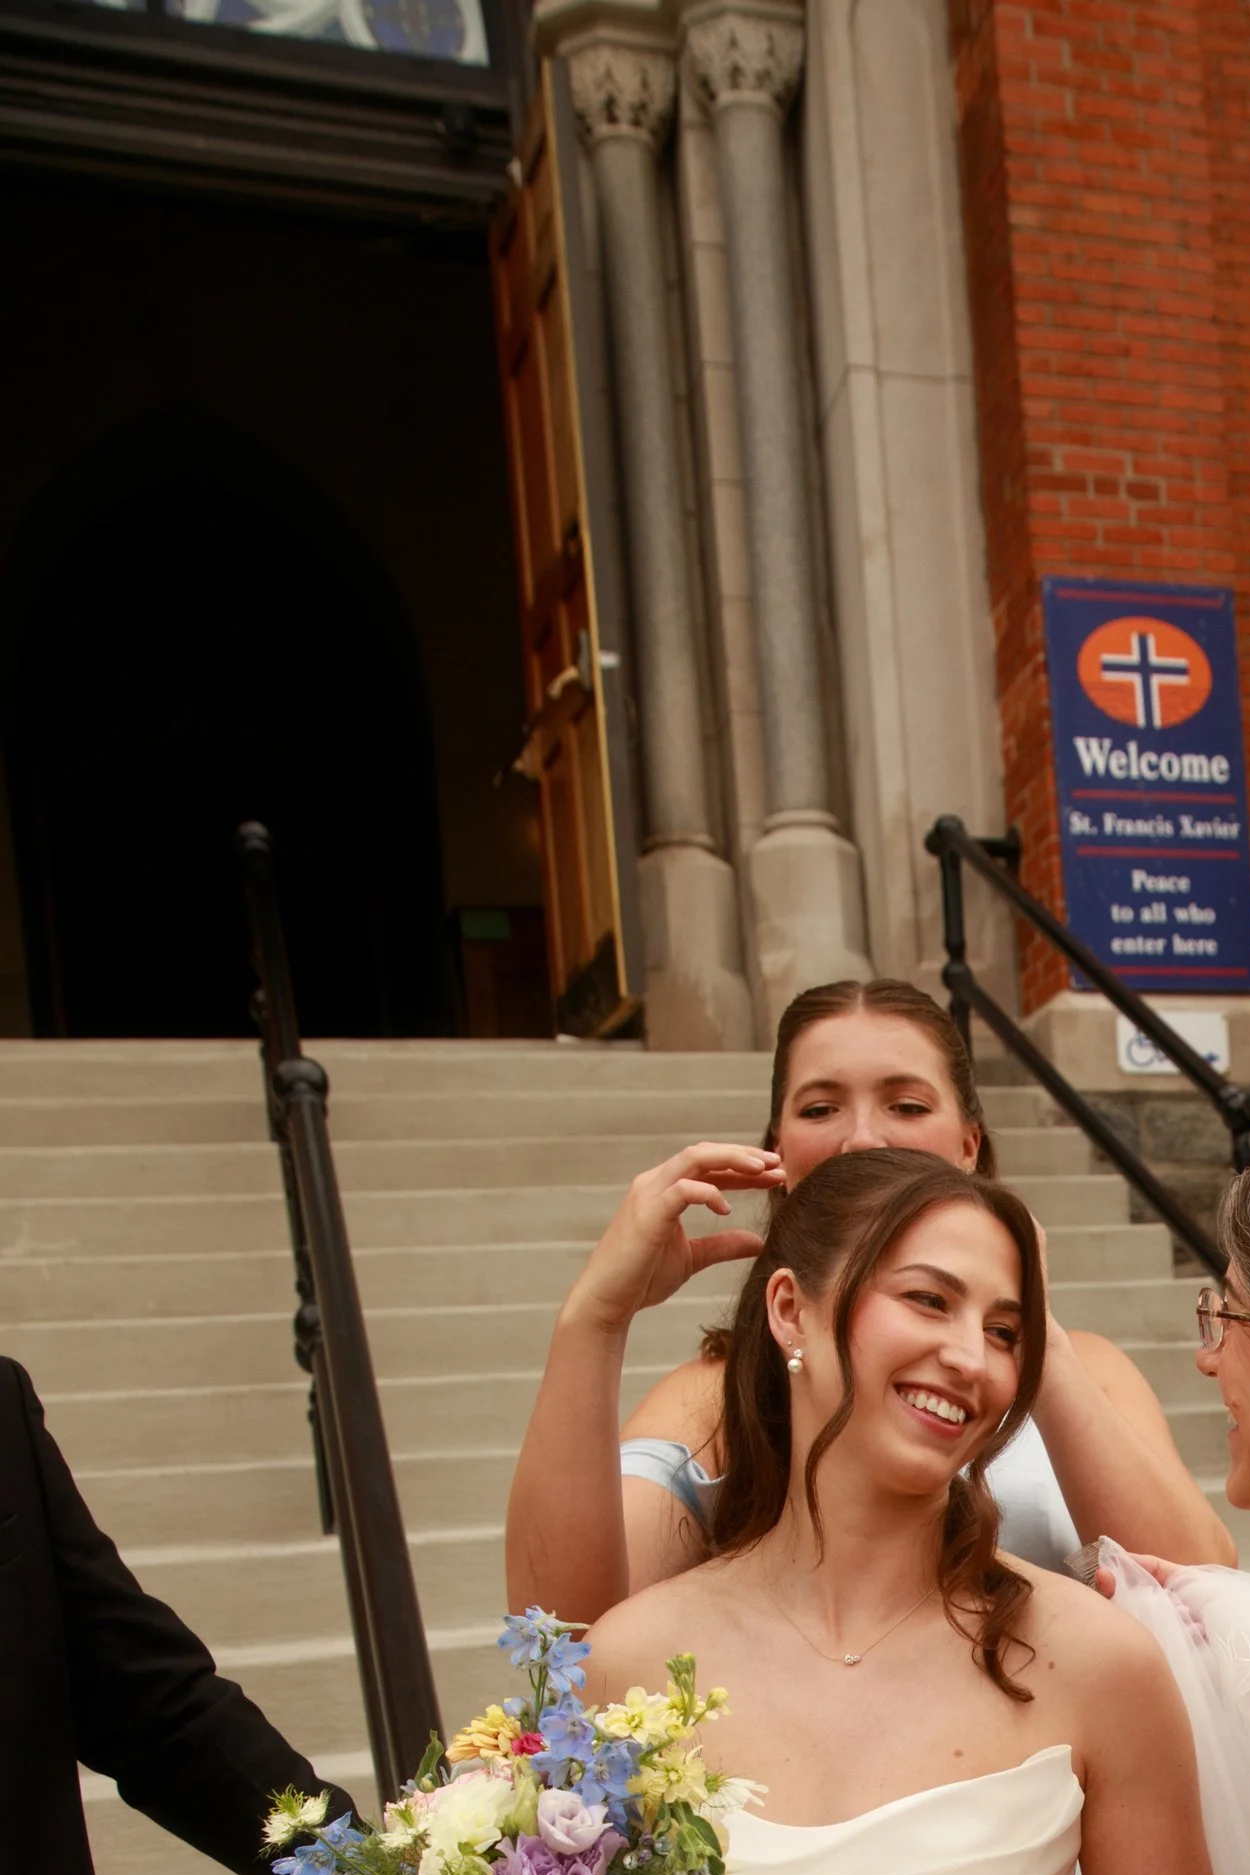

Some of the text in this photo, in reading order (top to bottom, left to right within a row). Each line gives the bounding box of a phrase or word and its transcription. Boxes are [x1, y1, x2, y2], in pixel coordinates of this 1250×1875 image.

[1073, 736, 1230, 785] Welcome
[1069, 811, 1241, 840] St. Francis Xavier
[1131, 869, 1191, 894] Peace
[1110, 901, 1216, 926] to all who
[1110, 932, 1218, 957] enter here
